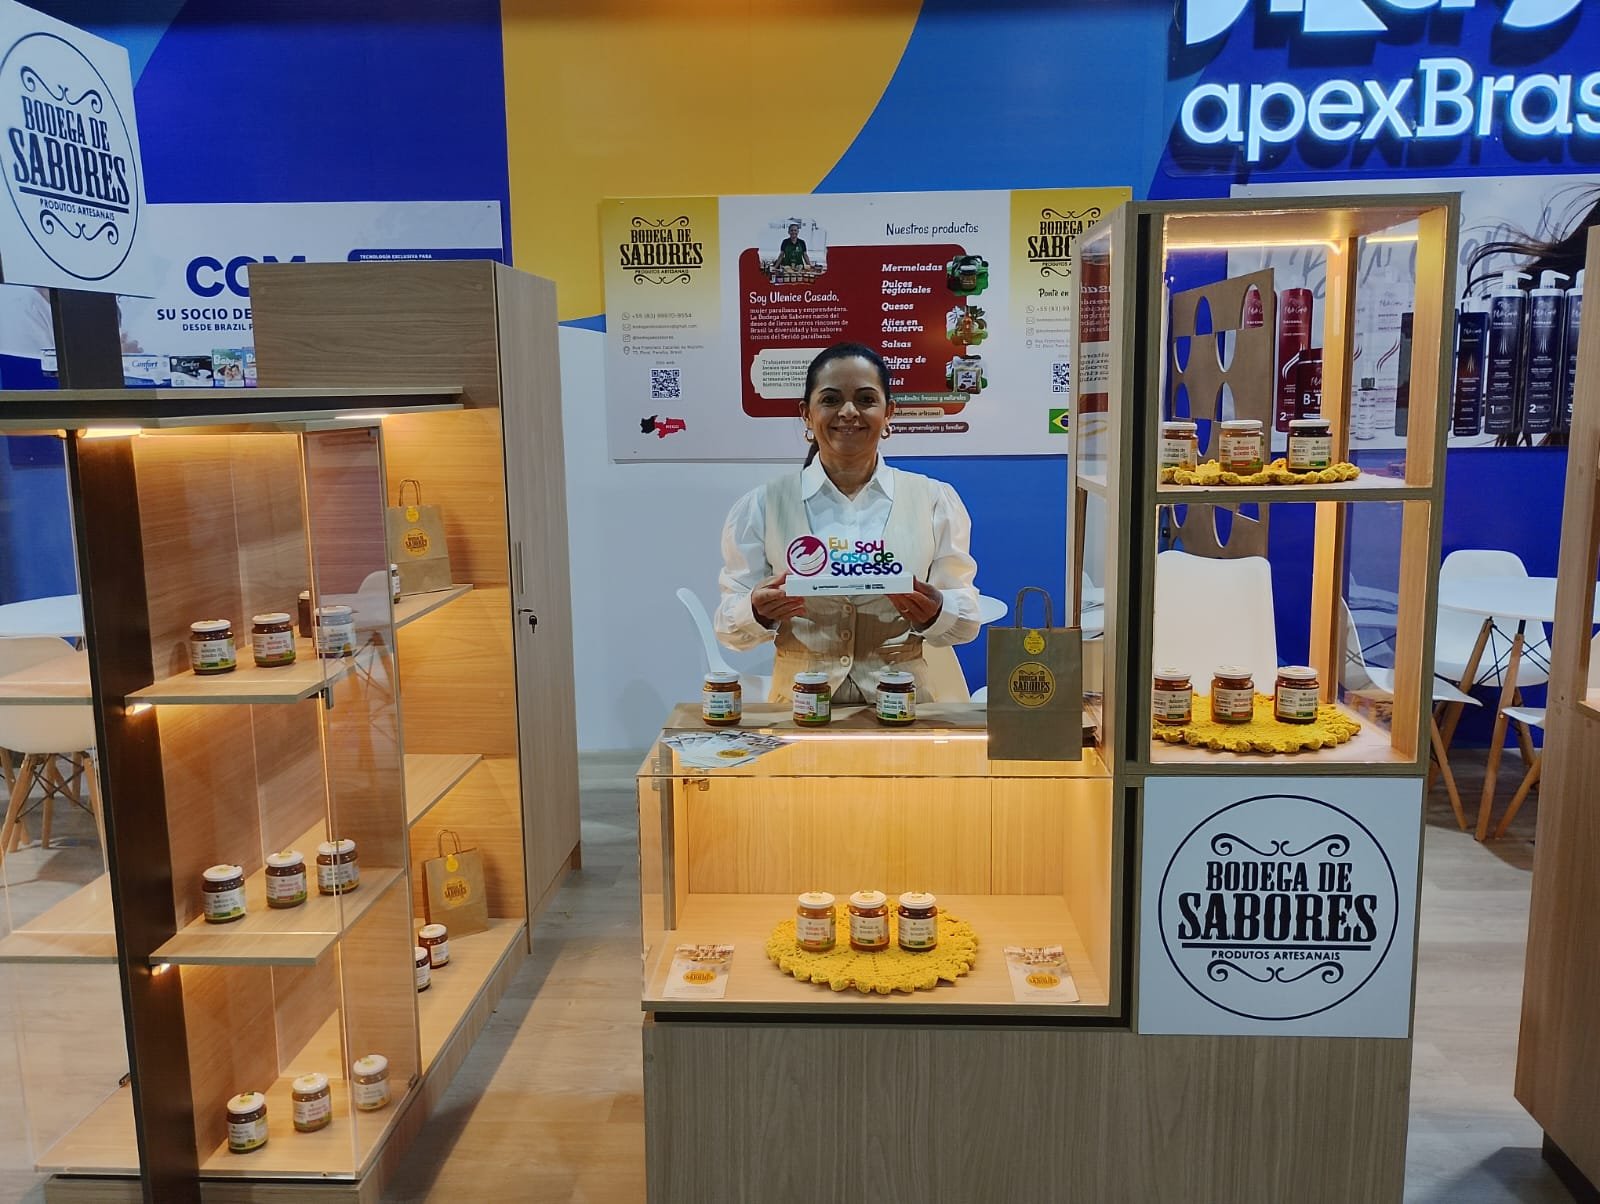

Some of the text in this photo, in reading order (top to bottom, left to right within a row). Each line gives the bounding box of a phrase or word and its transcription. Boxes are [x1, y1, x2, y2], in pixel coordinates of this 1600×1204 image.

[21, 95, 110, 152] BODEGA DE
[8, 127, 130, 205] SABORES
[40, 198, 116, 221] PRODUTOS ARTESANAIS
[886, 221, 979, 237] Nuestros productos
[1039, 220, 1083, 236] BODEGA
[631, 228, 691, 243] BODEGA DE
[619, 243, 704, 266] SABORES
[882, 263, 943, 272] Mermeladas
[882, 280, 912, 288] Dulces
[882, 286, 931, 296] regionales
[1038, 288, 1059, 298] Ponte
[749, 291, 767, 306] Soy
[769, 291, 802, 304] Ulenice
[881, 302, 914, 311] Quesos
[157, 308, 252, 320] SU SOCIO DE
[214, 323, 247, 331] BRAZIL
[881, 340, 912, 348] Salsas
[914, 355, 927, 364] de
[886, 362, 911, 370] rutas
[1490, 405, 1496, 414] 1
[1528, 404, 1537, 414] 2
[1279, 412, 1287, 421] 2
[828, 537, 849, 550] Eu
[829, 549, 894, 564] Caso de
[1206, 861, 1353, 893] BODEGA DE
[1177, 892, 1378, 943] SABORES
[1211, 950, 1341, 961] PRODUTOS ARTESANAIS
